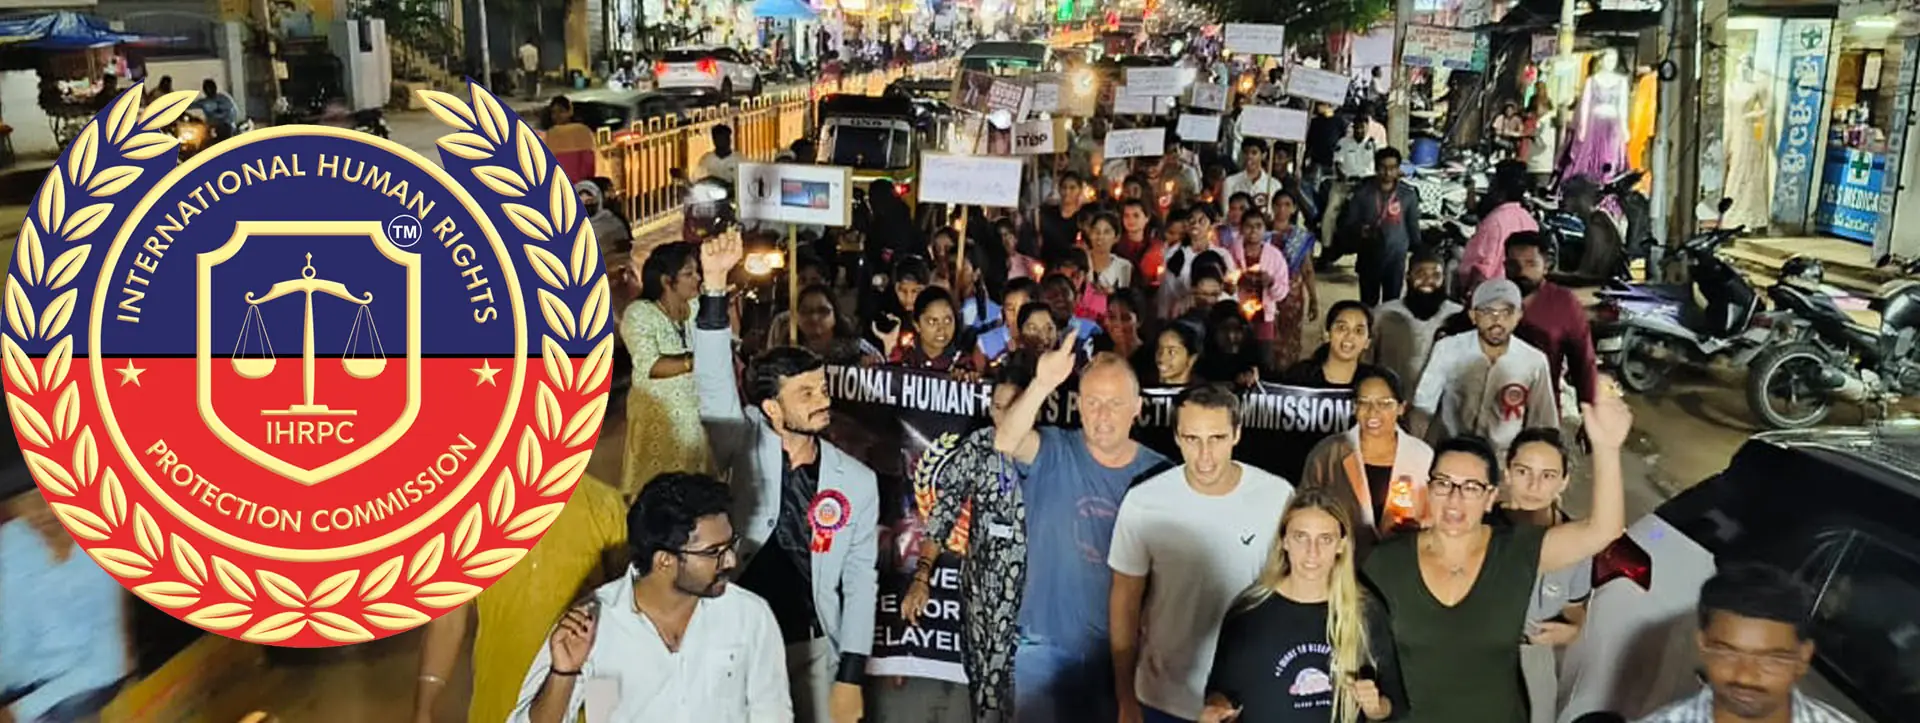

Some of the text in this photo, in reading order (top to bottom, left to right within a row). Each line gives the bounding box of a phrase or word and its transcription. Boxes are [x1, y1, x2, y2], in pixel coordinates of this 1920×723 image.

[1843, 186, 1880, 212] MEDICA
[826, 365, 896, 404] TIONAL
[902, 374, 974, 416] HUMAN
[1240, 393, 1352, 433] MMISSION
[922, 598, 961, 621] OR
